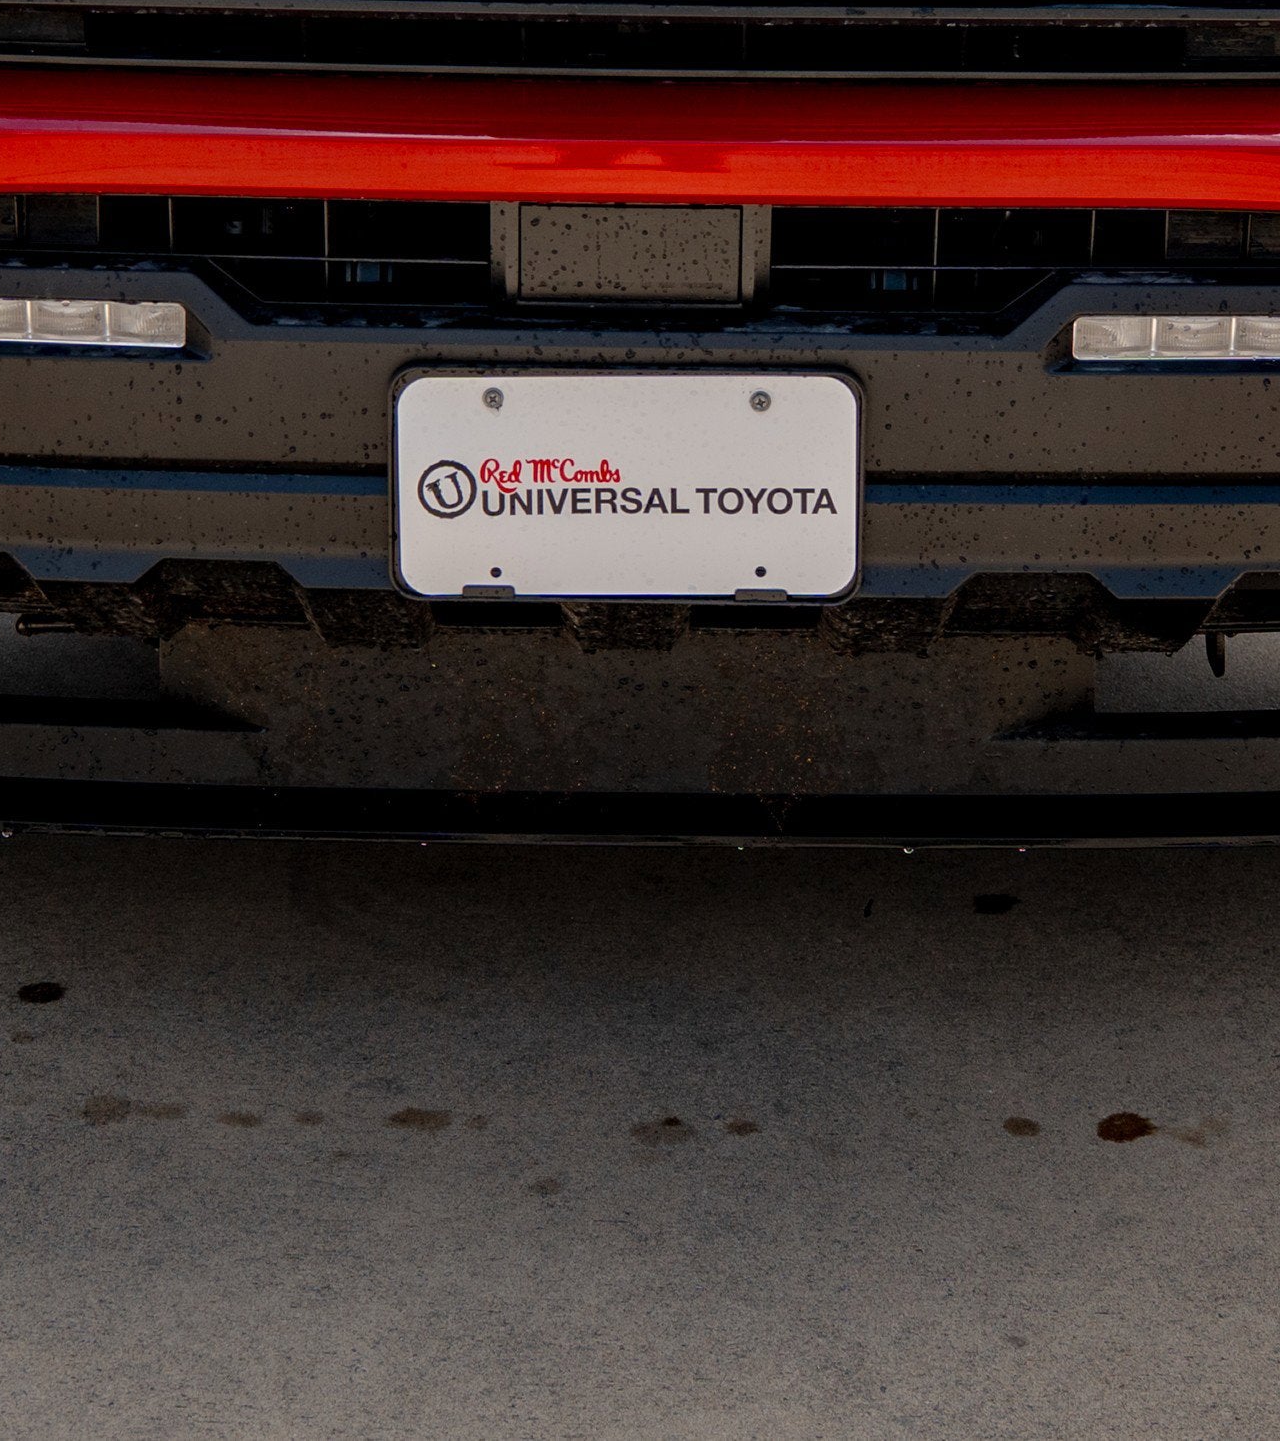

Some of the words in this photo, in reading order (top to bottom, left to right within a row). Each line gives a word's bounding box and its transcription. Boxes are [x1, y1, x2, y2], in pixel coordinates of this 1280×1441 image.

[479, 457, 522, 494] Red
[525, 458, 621, 483] McCombs
[481, 486, 690, 517] UNIVERSAL
[694, 487, 838, 515] TOYOTA
